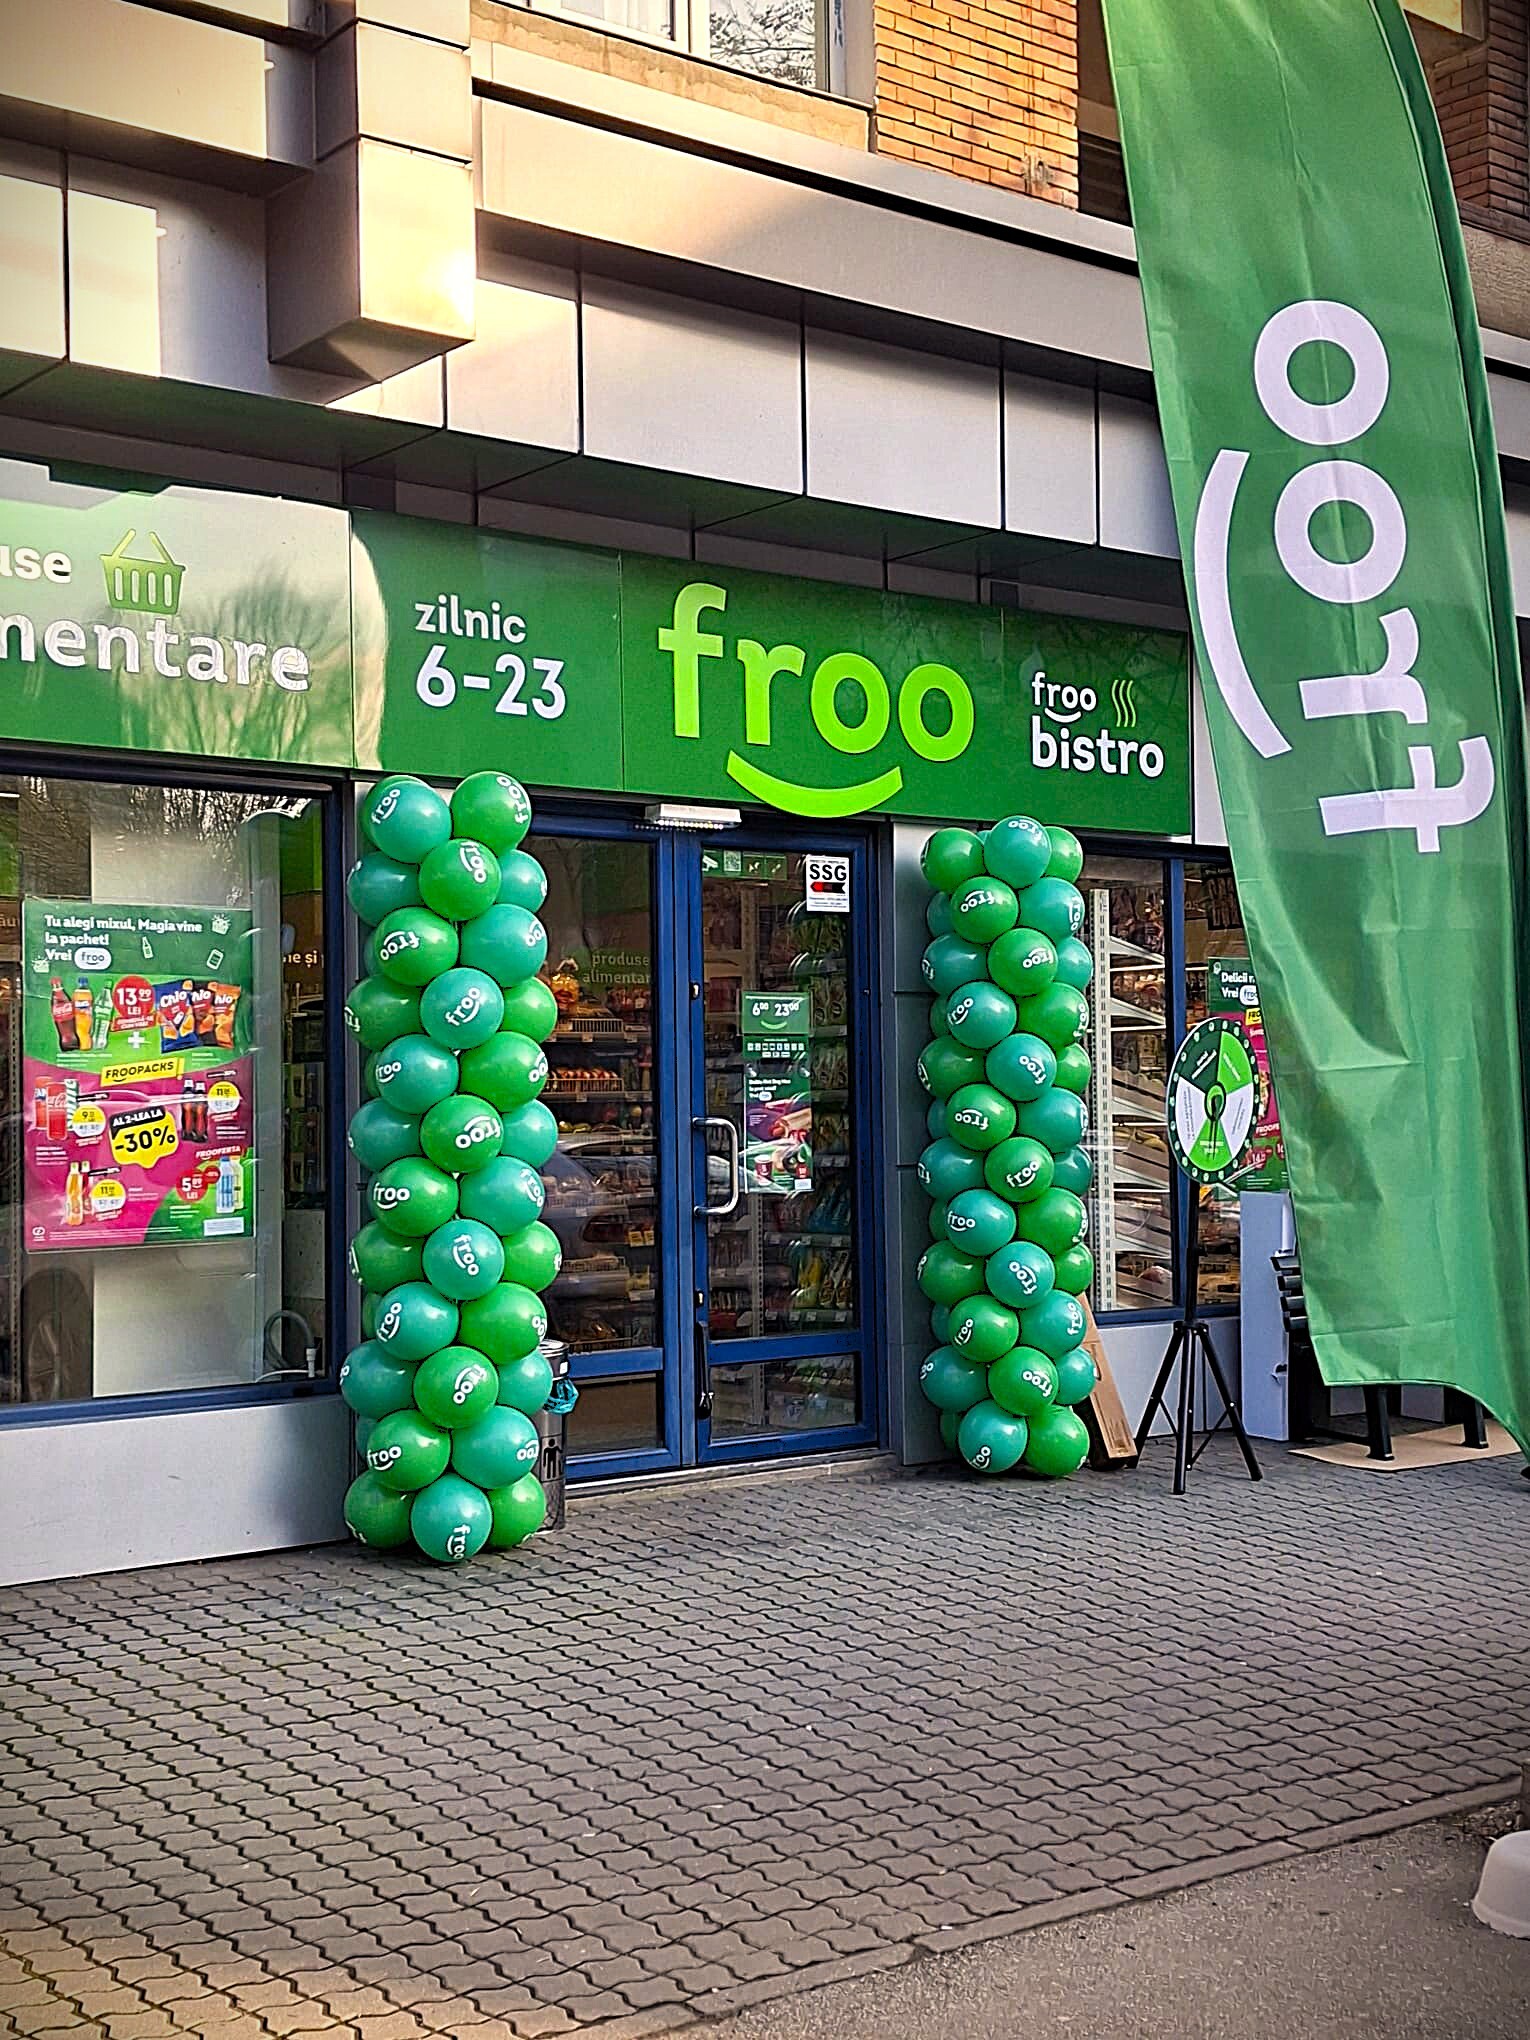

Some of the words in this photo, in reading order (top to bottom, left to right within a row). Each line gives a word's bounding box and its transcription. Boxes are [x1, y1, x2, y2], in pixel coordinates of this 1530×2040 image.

[1253, 299, 1495, 853] froo
[415, 594, 527, 644] zilnic
[416, 645, 566, 720] 6-23
[658, 583, 975, 763] froo
[1031, 671, 1097, 712] froo
[1031, 715, 1165, 779] bistro
[371, 788, 401, 825] froo
[497, 776, 529, 824] froo
[1008, 820, 1043, 842] froo
[809, 863, 847, 882] SSG
[961, 890, 996, 913] froo
[44, 915, 62, 928] Tu
[63, 915, 95, 931] alegi
[138, 918, 175, 933] Magia
[176, 920, 203, 933] vine
[45, 932, 59, 945] la
[380, 932, 420, 960] froo
[45, 949, 73, 962] Vrei
[81, 953, 105, 963] froo
[1023, 950, 1053, 969] froo
[117, 987, 138, 1006] 13
[160, 990, 187, 1008] Chio
[191, 989, 212, 1002] hio
[214, 993, 234, 1005] hio
[446, 987, 481, 1026] froo
[128, 1006, 142, 1015] LEI
[105, 1061, 175, 1079] FROOPACKS
[1019, 1056, 1046, 1085] froo
[113, 1116, 126, 1128] AL
[150, 1108, 164, 1121] LA
[955, 1112, 989, 1131] froo
[115, 1126, 177, 1153] -30%
[455, 1117, 500, 1149] froo
[182, 1177, 192, 1192] 5
[1006, 1161, 1040, 1188] froo
[373, 1182, 411, 1201] froo
[947, 1211, 976, 1228] froo
[454, 1234, 480, 1276] froo
[1009, 1261, 1037, 1295] froo
[376, 1302, 402, 1343] froo
[1067, 1303, 1081, 1336] froo
[453, 1364, 487, 1404] froo
[1023, 1371, 1053, 1398] froo
[367, 1446, 402, 1468] froo
[453, 1524, 471, 1560] froo
